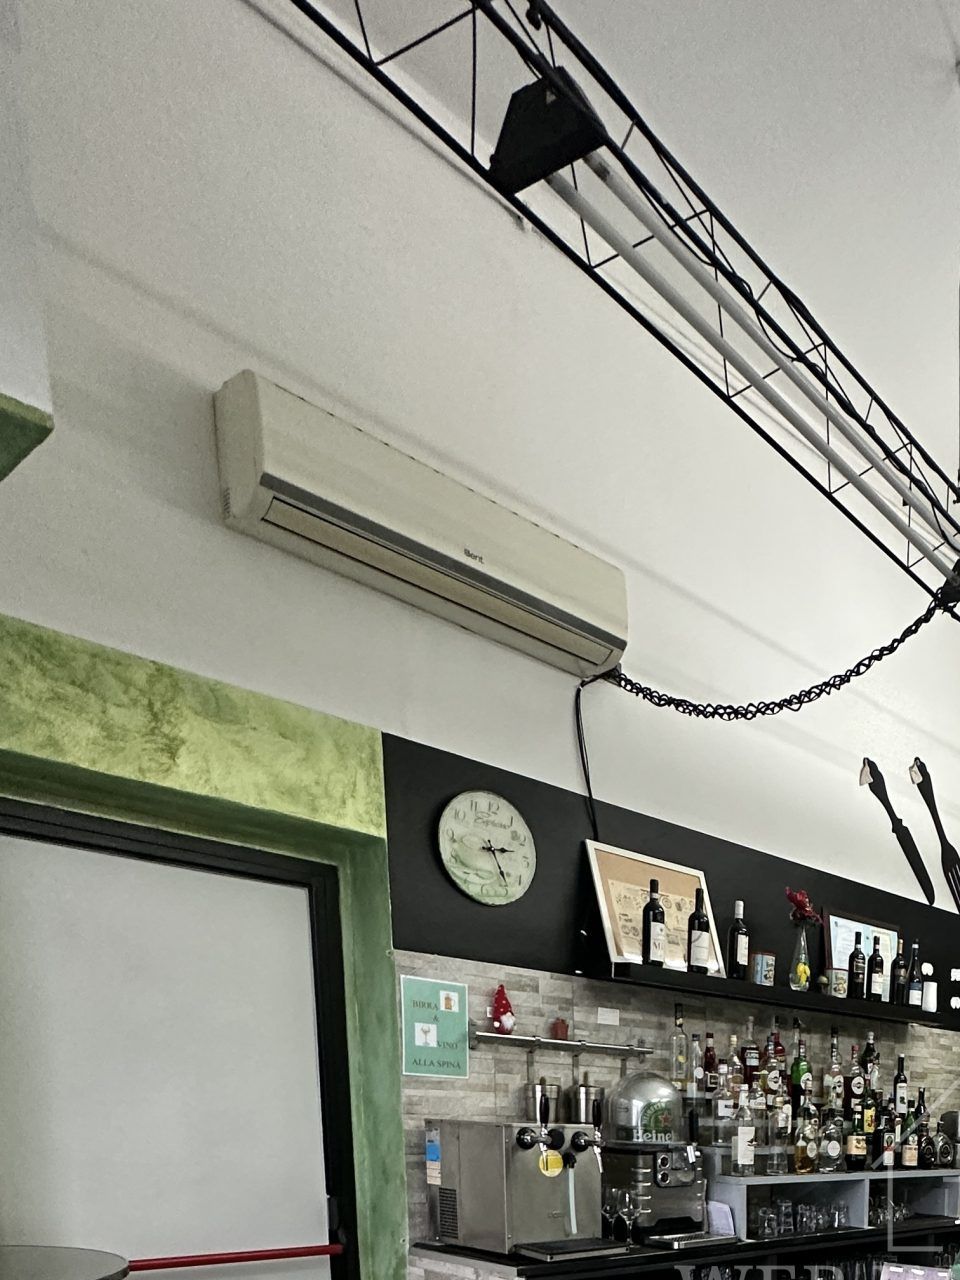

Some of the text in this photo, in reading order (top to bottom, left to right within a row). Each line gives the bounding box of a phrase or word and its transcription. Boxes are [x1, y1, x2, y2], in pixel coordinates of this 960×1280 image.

[413, 1000, 439, 1011] BIRRA
[437, 1040, 458, 1050] VINO
[412, 1058, 461, 1070] ALLA SPINA
